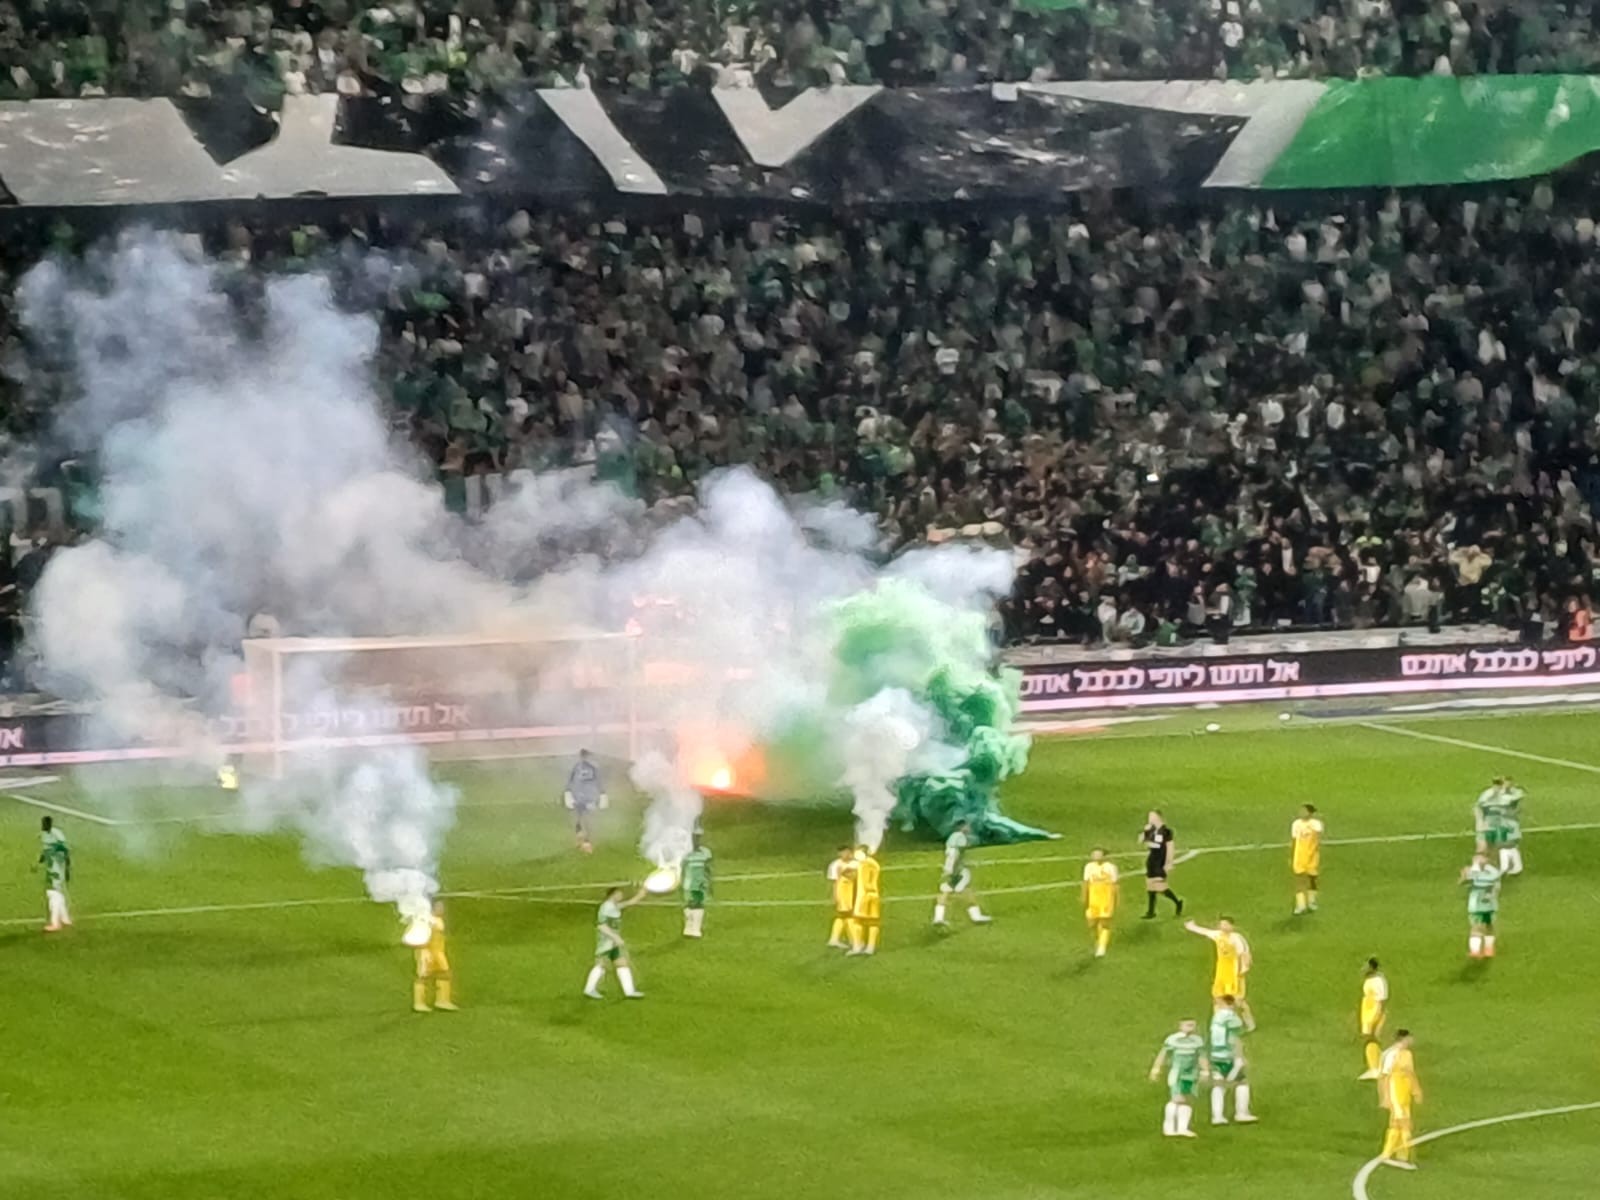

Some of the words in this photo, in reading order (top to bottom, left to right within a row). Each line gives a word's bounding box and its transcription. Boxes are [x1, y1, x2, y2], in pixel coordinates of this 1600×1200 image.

[1266, 658, 1300, 682] אל
[1401, 653, 1467, 676] אתכם
[1020, 672, 1070, 695] אתכ
[434, 702, 472, 726] אל
